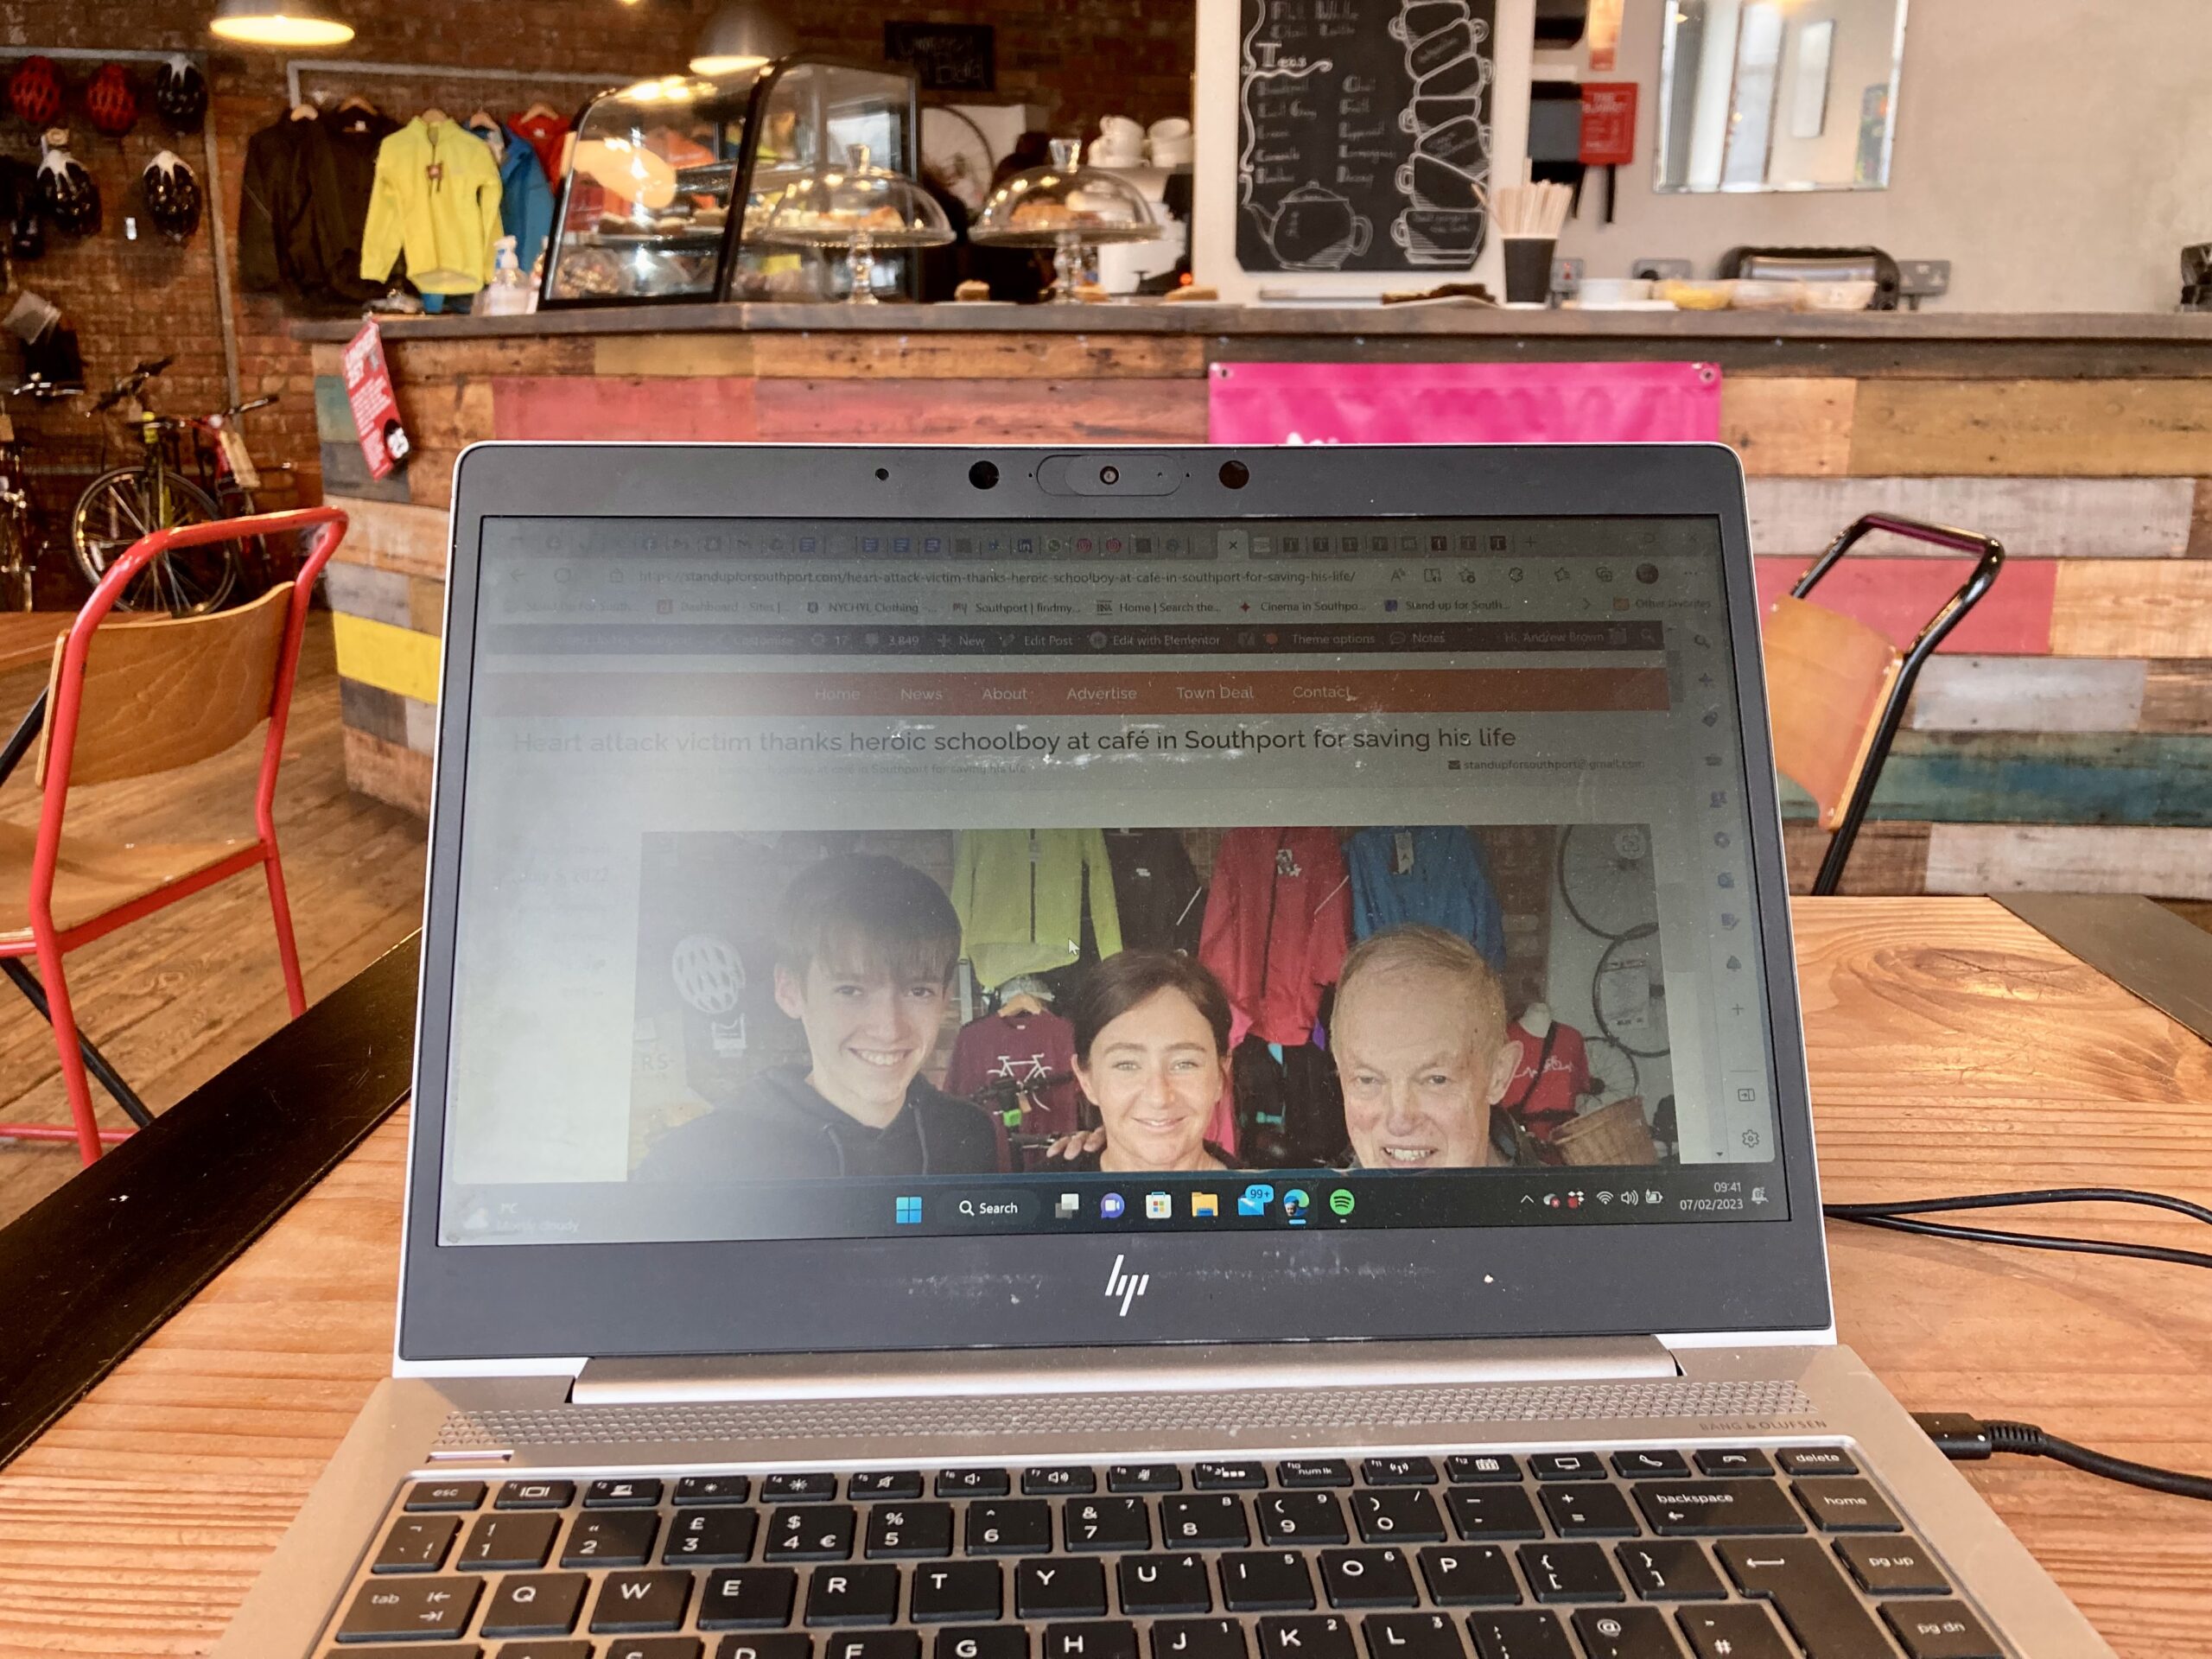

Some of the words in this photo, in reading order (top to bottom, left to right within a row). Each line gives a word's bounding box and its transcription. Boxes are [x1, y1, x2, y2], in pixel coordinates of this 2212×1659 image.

[1255, 42, 1306, 67] Teas
[681, 601, 738, 613] Dashboard
[874, 602, 919, 615] Clothing
[976, 602, 1027, 614] Southport
[1120, 602, 1144, 613] Home
[1159, 602, 1192, 613] Search
[1261, 601, 1299, 612] Cinema
[1406, 601, 1434, 610] Stand
[1438, 602, 1452, 612] up
[1454, 601, 1469, 610] for
[960, 635, 985, 645] New
[1025, 635, 1046, 645] Edit
[1049, 635, 1073, 645] Post
[1113, 635, 1134, 645] Edit
[1137, 635, 1161, 645] with
[1164, 635, 1221, 645] Elementor
[1291, 634, 1329, 644] Theme
[1332, 634, 1375, 646] options
[1413, 632, 1445, 643] Notes
[1569, 632, 1605, 642] Brown
[815, 688, 861, 701] Home
[900, 688, 944, 701] News
[982, 687, 1027, 700] About
[1066, 687, 1138, 700] Advertise
[1176, 687, 1215, 699] Town
[1220, 685, 1255, 699] Deal
[1293, 685, 1351, 698] Contact
[513, 733, 583, 753] Heart
[590, 733, 668, 753] attack
[677, 732, 751, 752] victim
[760, 732, 842, 752] thanks
[850, 732, 926, 751] heroic
[934, 731, 1060, 754] schoolboy
[1067, 734, 1091, 750] at
[1097, 730, 1150, 750] café
[1157, 731, 1178, 749] in
[1185, 729, 1306, 753] Southport
[1314, 729, 1346, 748] for
[1353, 729, 1430, 753] saving
[1439, 728, 1471, 747] his
[1479, 727, 1516, 747] life
[1249, 1188, 1270, 1199] 99+
[1713, 1182, 1742, 1192] 09:41
[980, 1201, 1018, 1214] Search
[1679, 1198, 1744, 1211] 07/02/2023
[1699, 1421, 1743, 1431] BANG
[1759, 1420, 1827, 1430] OLUFSEN
[1796, 1453, 1840, 1463] delete
[432, 1488, 459, 1497] esc
[1656, 1493, 1734, 1505] backspace
[1824, 1496, 1867, 1505] home
[787, 1515, 801, 1529] $
[886, 1512, 904, 1526] %
[1084, 1525, 1098, 1539] 7
[1183, 1522, 1198, 1536] 8
[1281, 1519, 1296, 1533] 9
[783, 1535, 800, 1549] 4
[884, 1531, 899, 1546] 5
[984, 1529, 1000, 1542] 6
[580, 1540, 598, 1554] 2
[683, 1537, 699, 1552] 3
[1342, 1560, 1364, 1576] O
[1440, 1557, 1458, 1573] P
[1869, 1557, 1891, 1567] pg
[1894, 1556, 1915, 1567] up
[1037, 1569, 1056, 1586] Y
[1137, 1565, 1157, 1582] U
[828, 1577, 847, 1593] R
[931, 1573, 948, 1590] T
[512, 1586, 537, 1603] Q
[620, 1582, 652, 1599] W
[721, 1580, 741, 1597] E
[372, 1593, 399, 1605] tab
[1387, 1626, 1406, 1644] L
[1916, 1624, 1940, 1635] pg
[1943, 1622, 1966, 1632] dn
[1172, 1631, 1187, 1649] J
[1281, 1628, 1302, 1646] K
[845, 1643, 864, 1659] F
[955, 1639, 978, 1658] G
[1064, 1635, 1084, 1654] H
